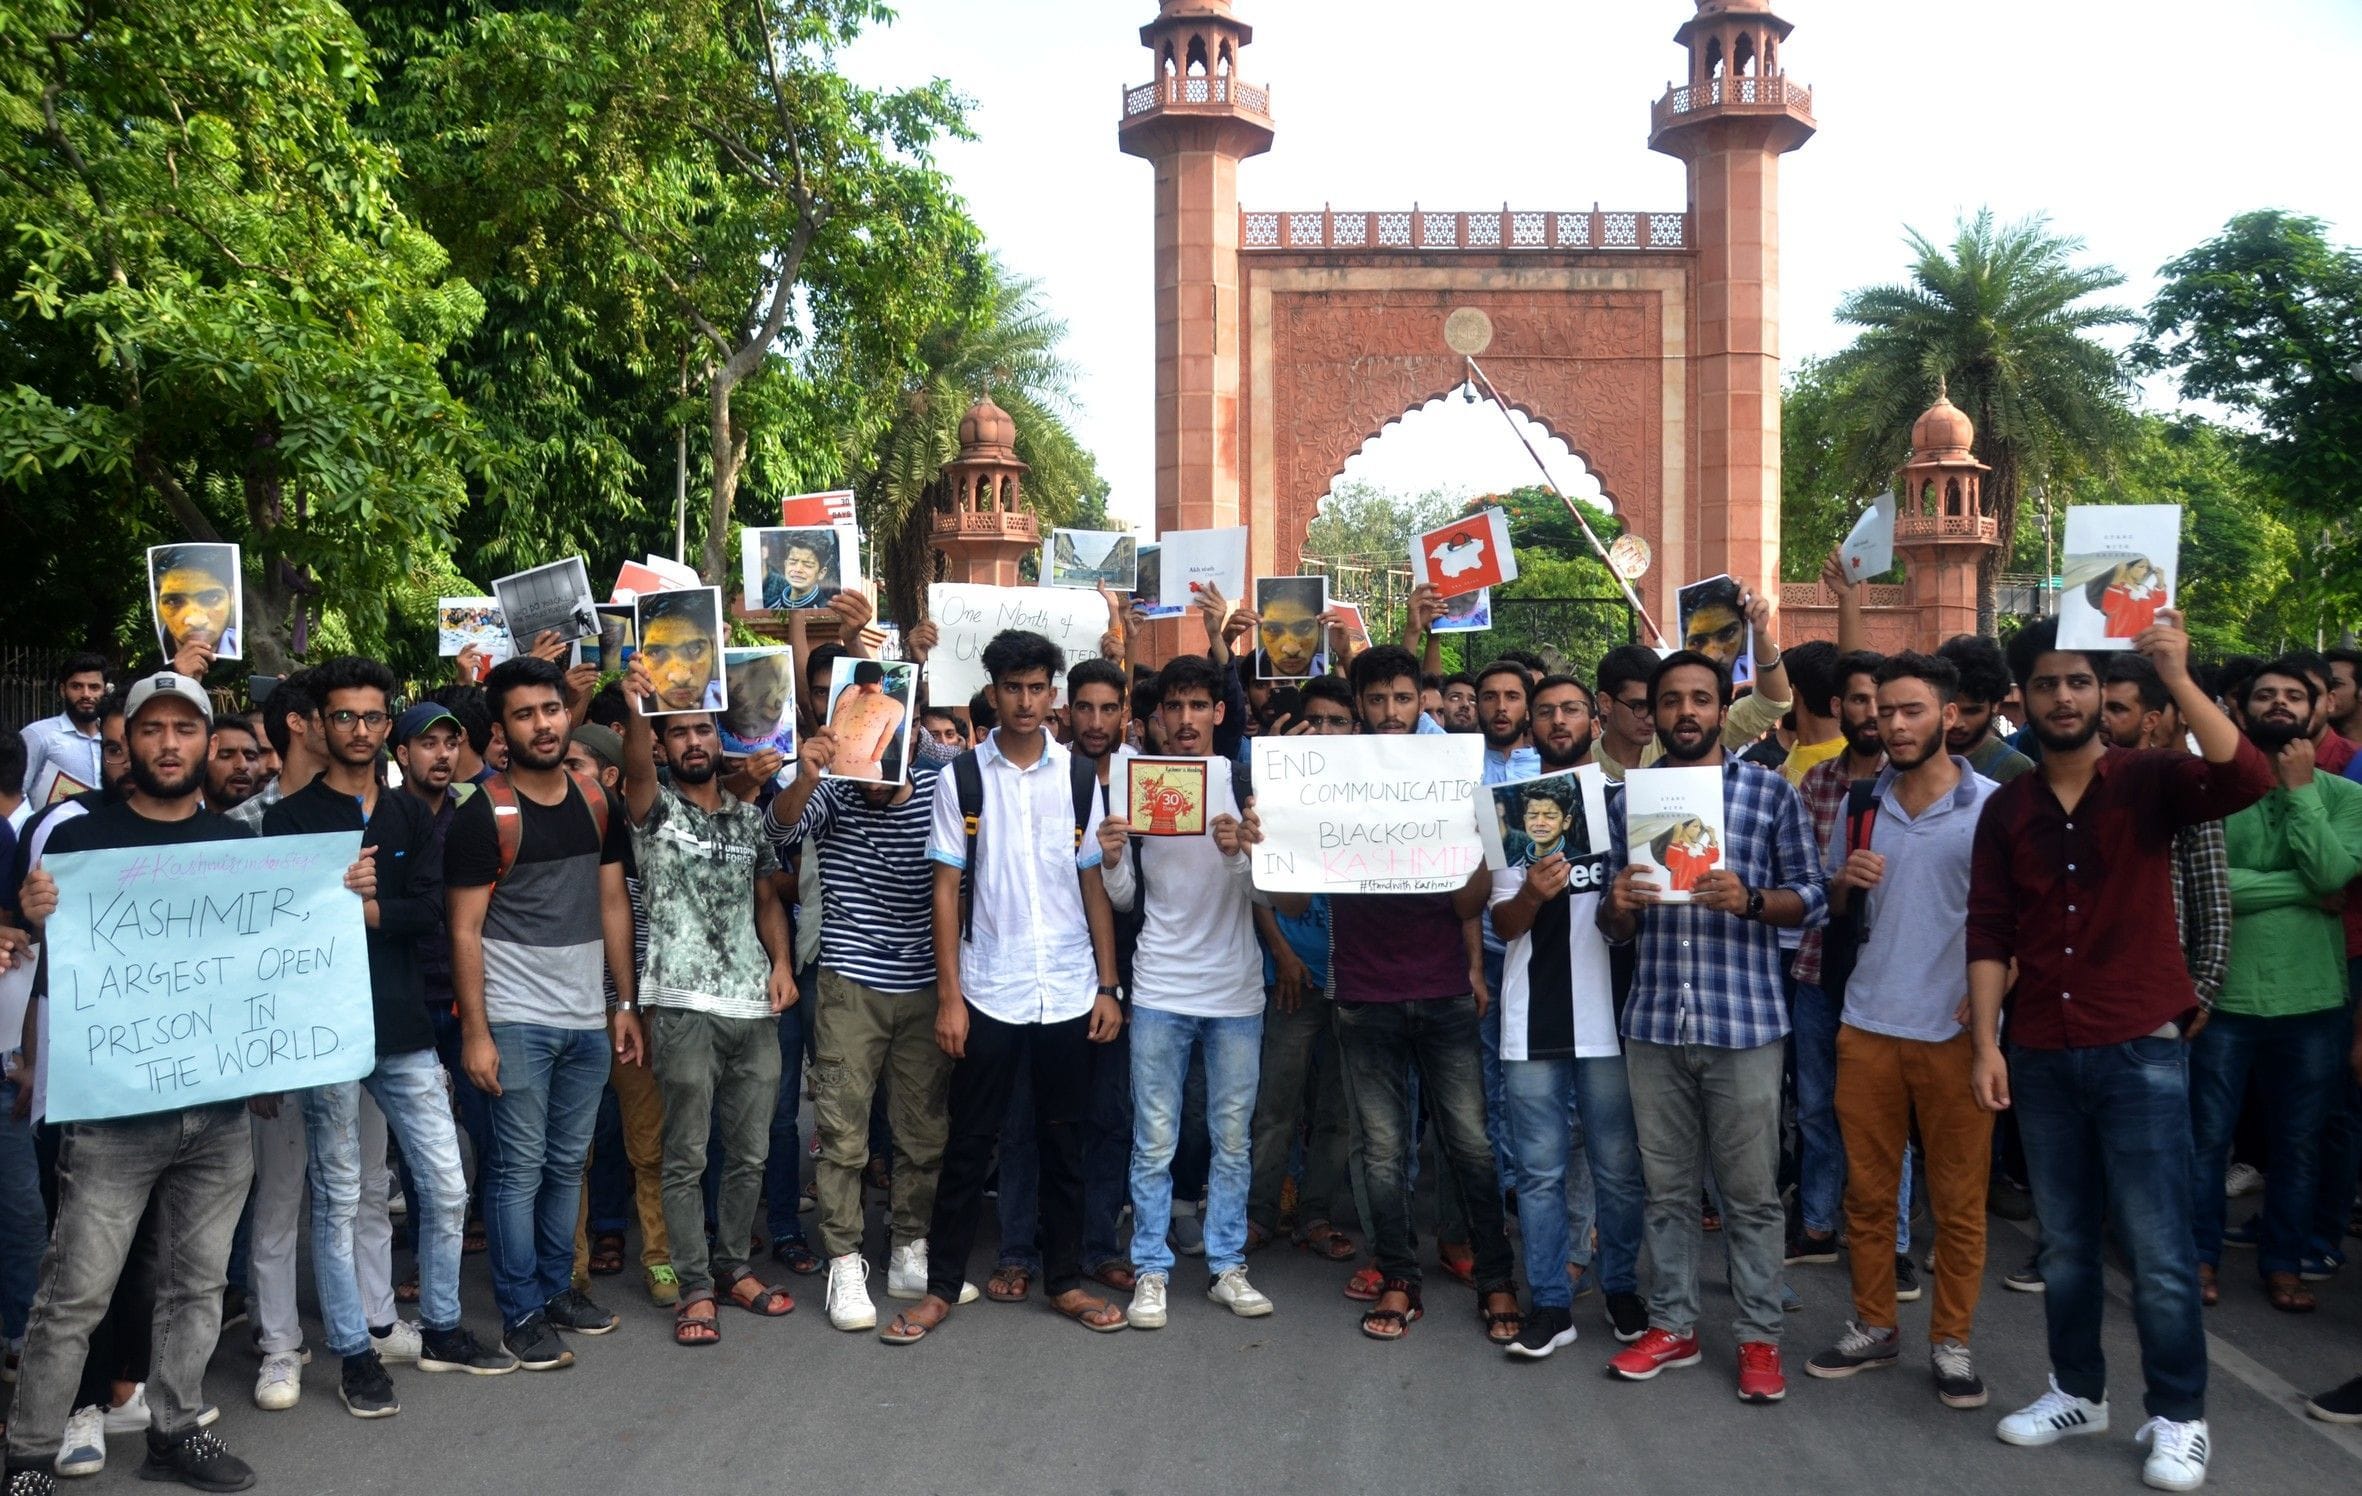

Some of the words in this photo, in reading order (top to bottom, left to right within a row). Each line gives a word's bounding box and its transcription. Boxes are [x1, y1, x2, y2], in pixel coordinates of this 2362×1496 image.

[942, 596, 981, 626] One
[997, 600, 1049, 629] Month
[1060, 614, 1073, 639] of
[1266, 750, 1326, 780] END
[1163, 793, 1180, 806] 30
[1319, 819, 1448, 849] BLACKOUT
[1264, 851, 1294, 874] IN
[90, 887, 310, 956] KASHMIR,
[74, 956, 235, 1011] LARGEST
[257, 936, 335, 981] OPEN
[88, 1003, 213, 1065] PRISON
[242, 993, 276, 1034] IN
[135, 1055, 201, 1093] THE
